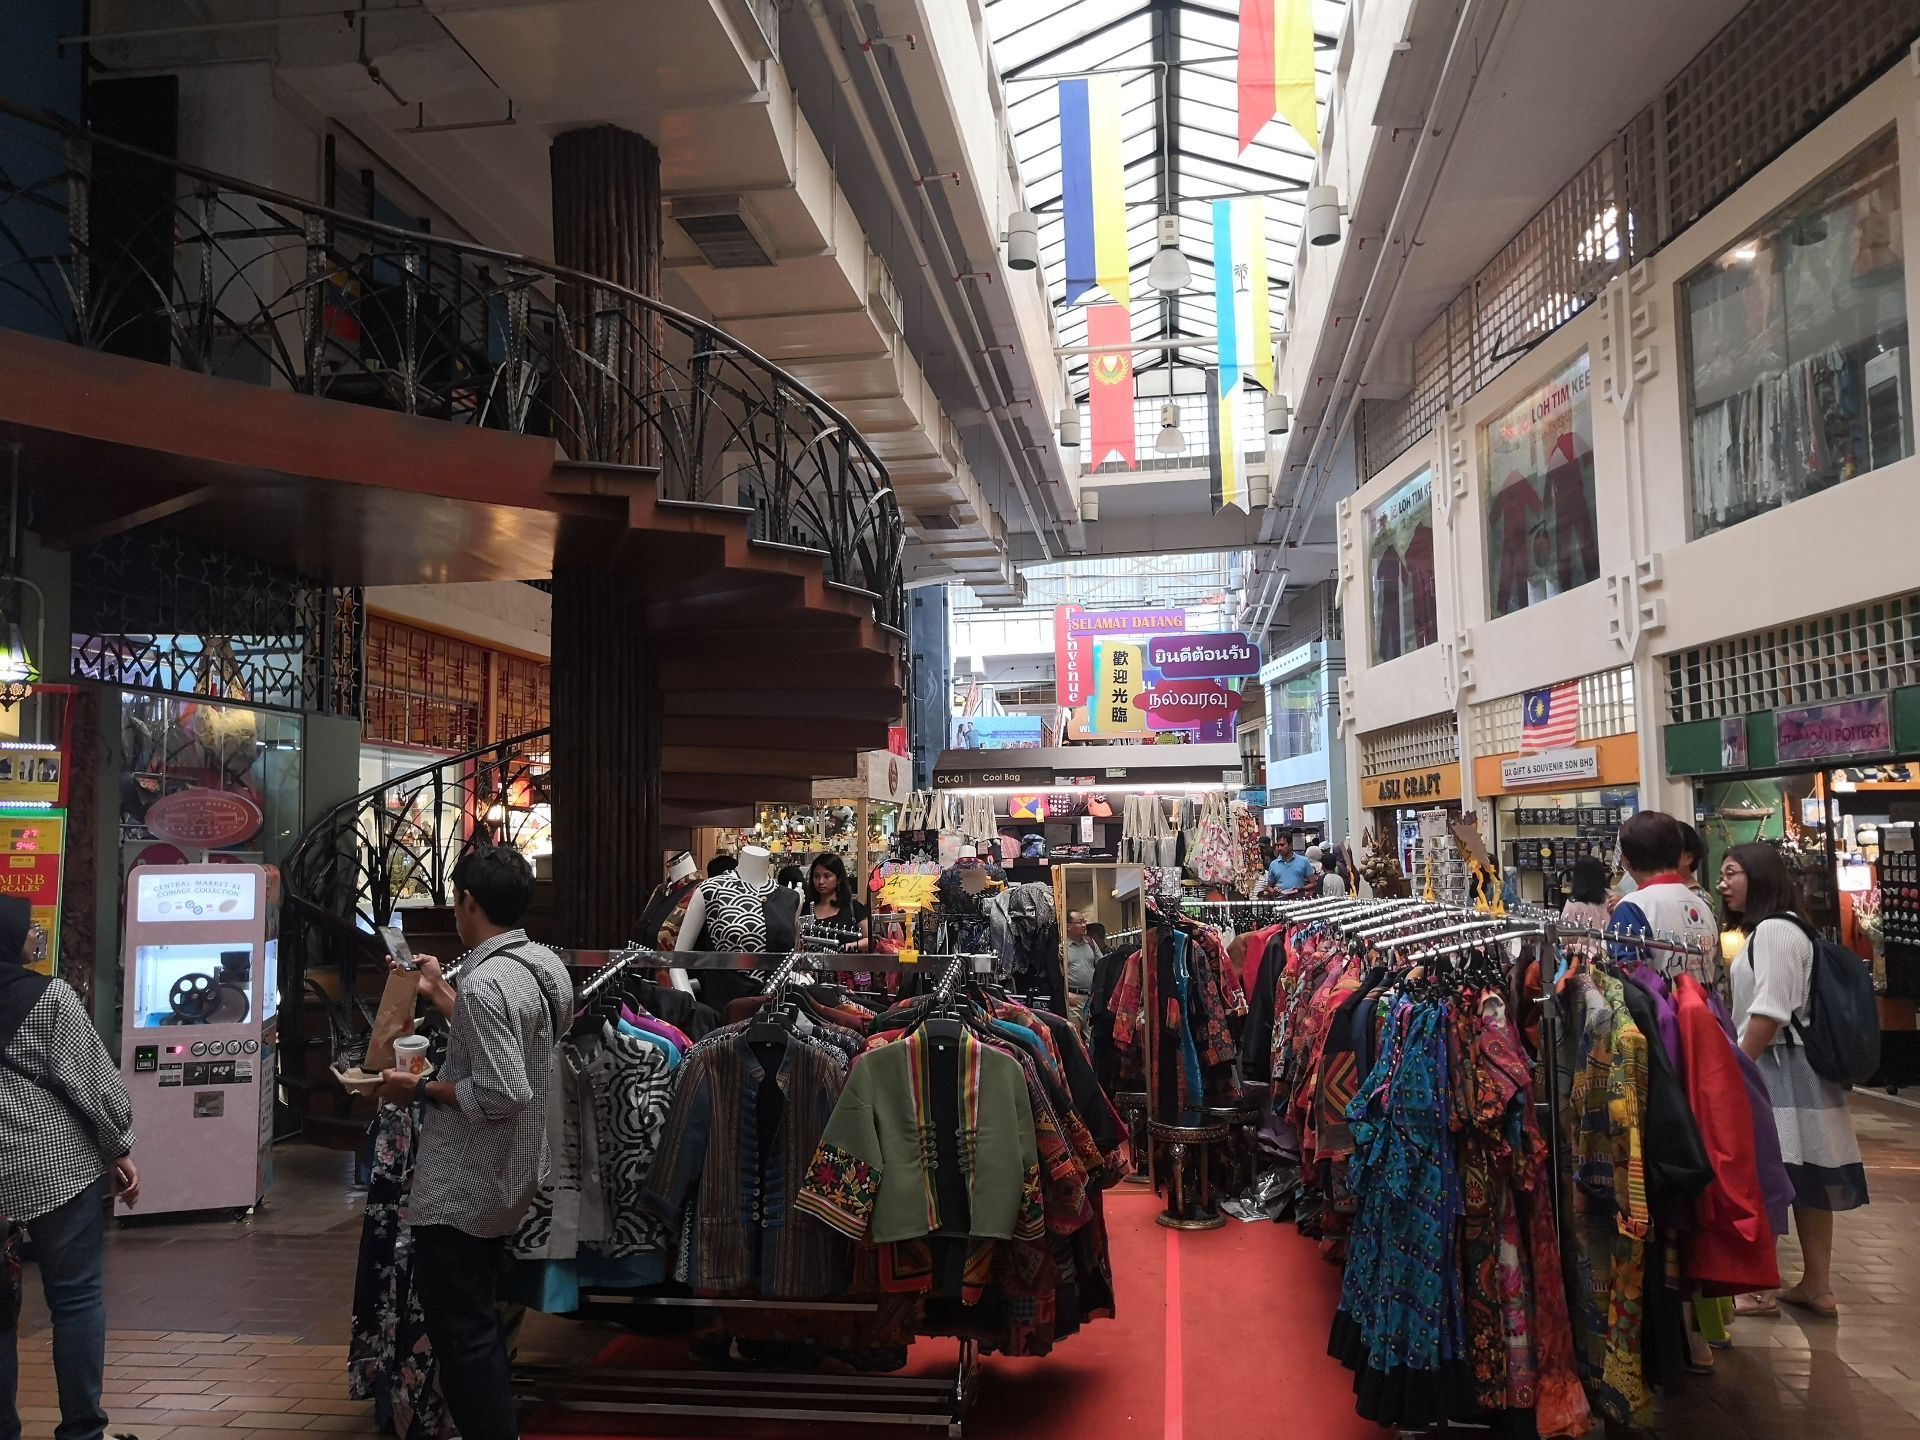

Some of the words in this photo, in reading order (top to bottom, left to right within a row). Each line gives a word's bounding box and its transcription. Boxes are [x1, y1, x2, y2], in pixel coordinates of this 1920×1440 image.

[1532, 398, 1550, 423] LOH
[1552, 384, 1569, 408] TIM
[1571, 369, 1590, 395] KEE
[1398, 496, 1411, 514] LOH
[1412, 487, 1424, 506] TIM
[1072, 617, 1128, 630] SELAMAT
[1132, 615, 1183, 628] DATANG
[1155, 644, 1250, 663] ยินดีต้อนรับ
[1111, 650, 1128, 722] 歡迎光臨
[1149, 689, 1228, 709] நல்வரவு
[1836, 722, 1881, 742] POTTERY
[1513, 765, 1526, 776] GIFT
[1532, 761, 1564, 773] SOUVENIR
[1565, 758, 1578, 769] SDN
[1579, 757, 1594, 767] BHD
[937, 775, 964, 784] CK-01
[982, 773, 1003, 781] Cool
[1004, 773, 1021, 783] Bag
[1403, 772, 1441, 798] CRAFT
[22, 829, 38, 838] 27
[0, 884, 40, 892] SCALES
[153, 880, 191, 892] CENTRAL
[195, 880, 228, 888] MARKET
[157, 887, 191, 898] COINAGE
[195, 886, 240, 897] COLLECTION
